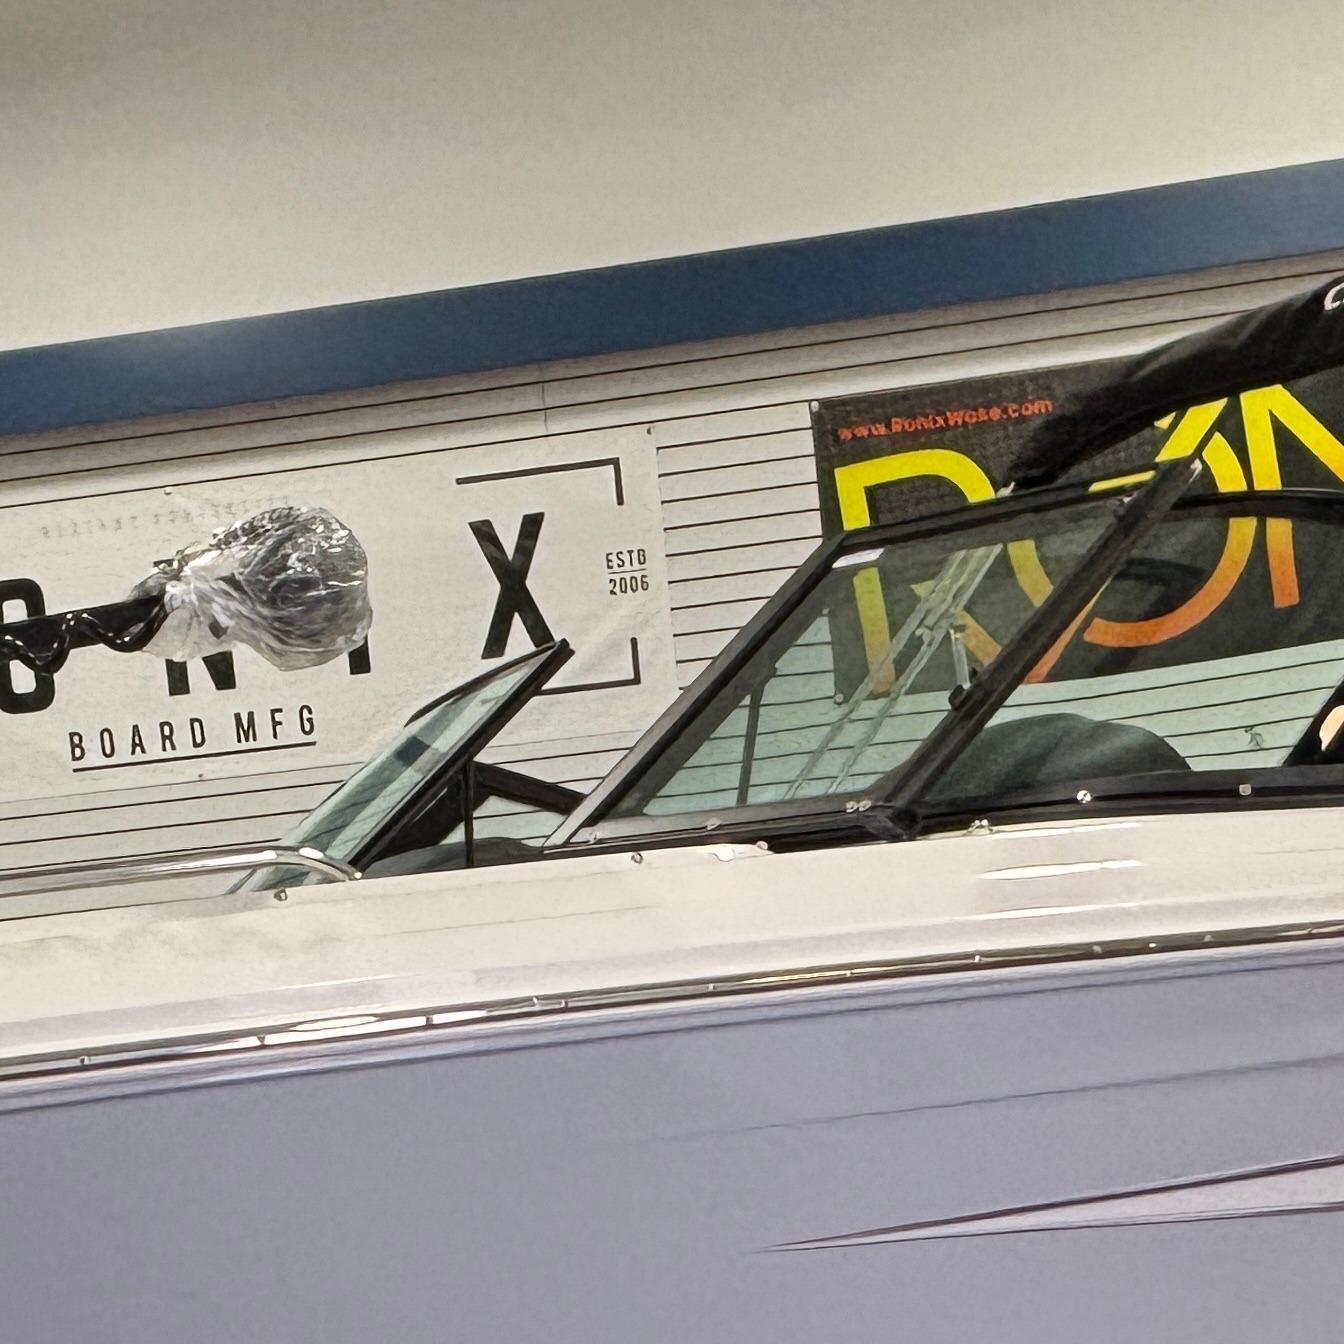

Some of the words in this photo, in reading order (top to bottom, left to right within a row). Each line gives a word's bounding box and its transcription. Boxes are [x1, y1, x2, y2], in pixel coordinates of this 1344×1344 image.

[605, 548, 647, 570] ESTB
[608, 574, 650, 596] 2006
[68, 717, 206, 762] BOARD
[233, 704, 315, 745] MFG
